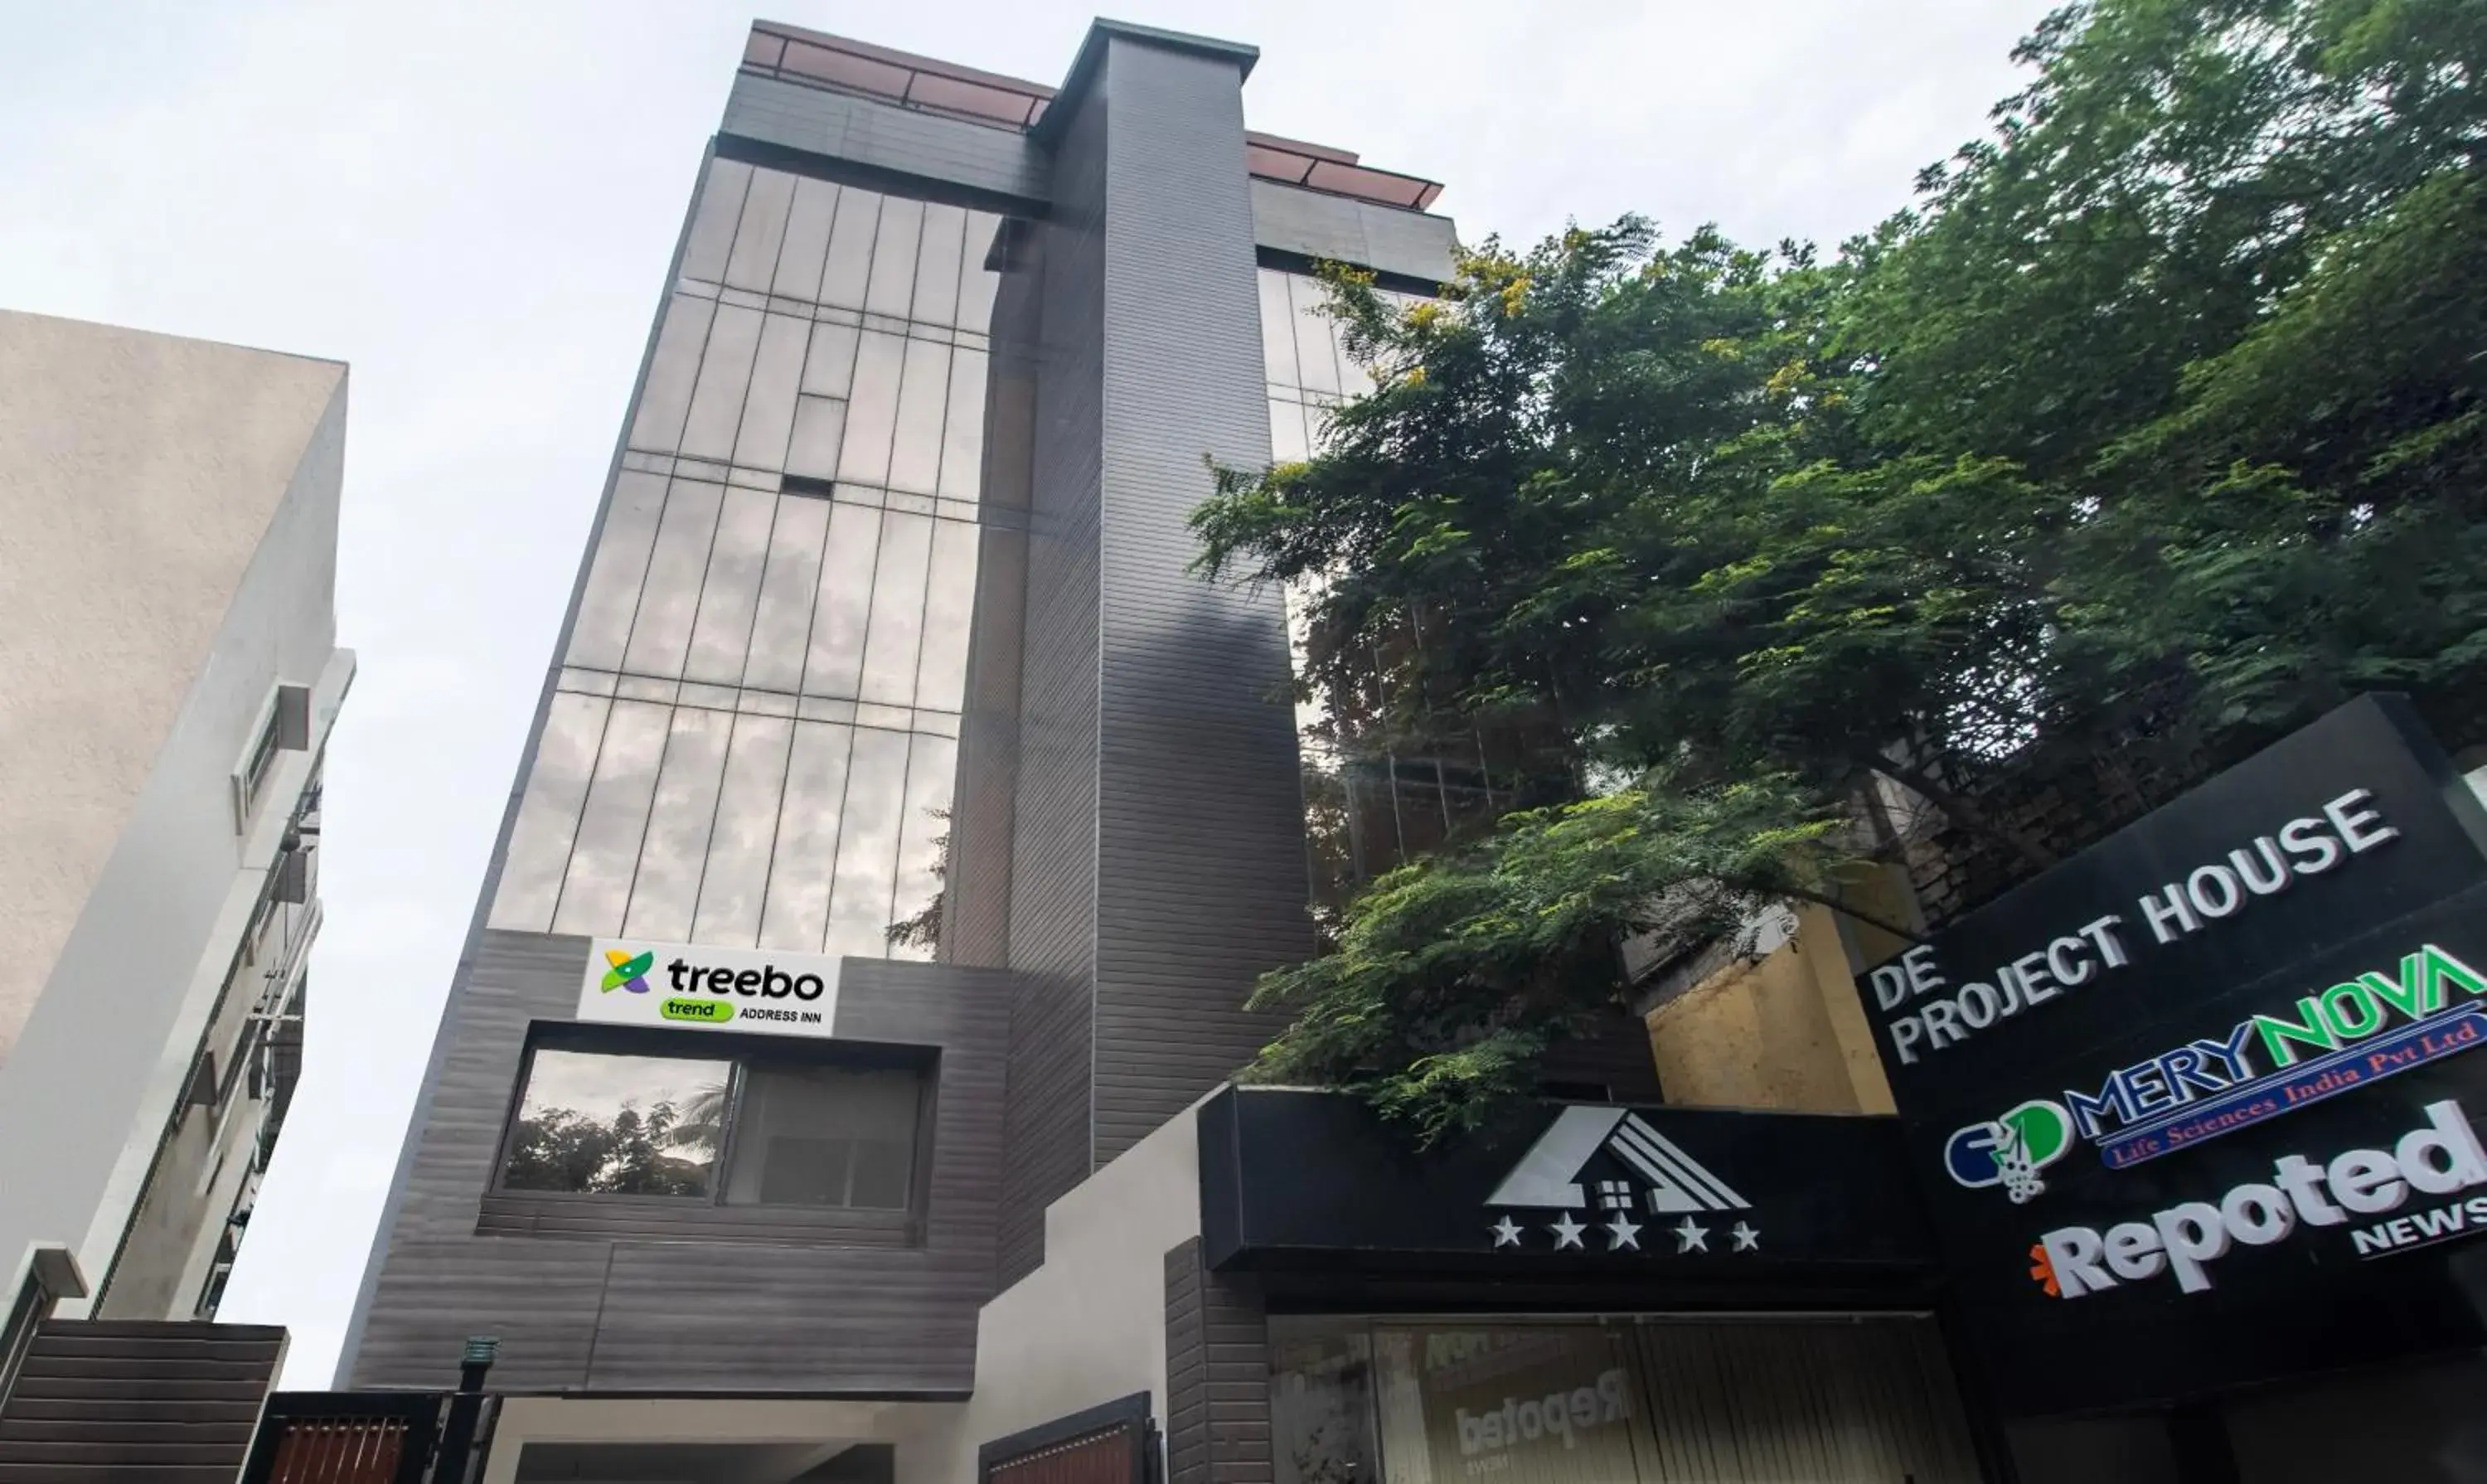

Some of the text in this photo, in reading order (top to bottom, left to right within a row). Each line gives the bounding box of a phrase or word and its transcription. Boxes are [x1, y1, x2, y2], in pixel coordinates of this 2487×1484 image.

[1888, 788, 2402, 1065] PROJECT HOUSE
[667, 958, 825, 1001] treebo
[1870, 944, 1946, 1012] DE
[667, 1001, 822, 1024] trend ADDRESS INN
[2113, 1020, 2480, 1165] Life Sciences India Pvt Ltd
[2041, 1099, 2487, 1299] Repoted
[2350, 1196, 2487, 1254] NEWS
